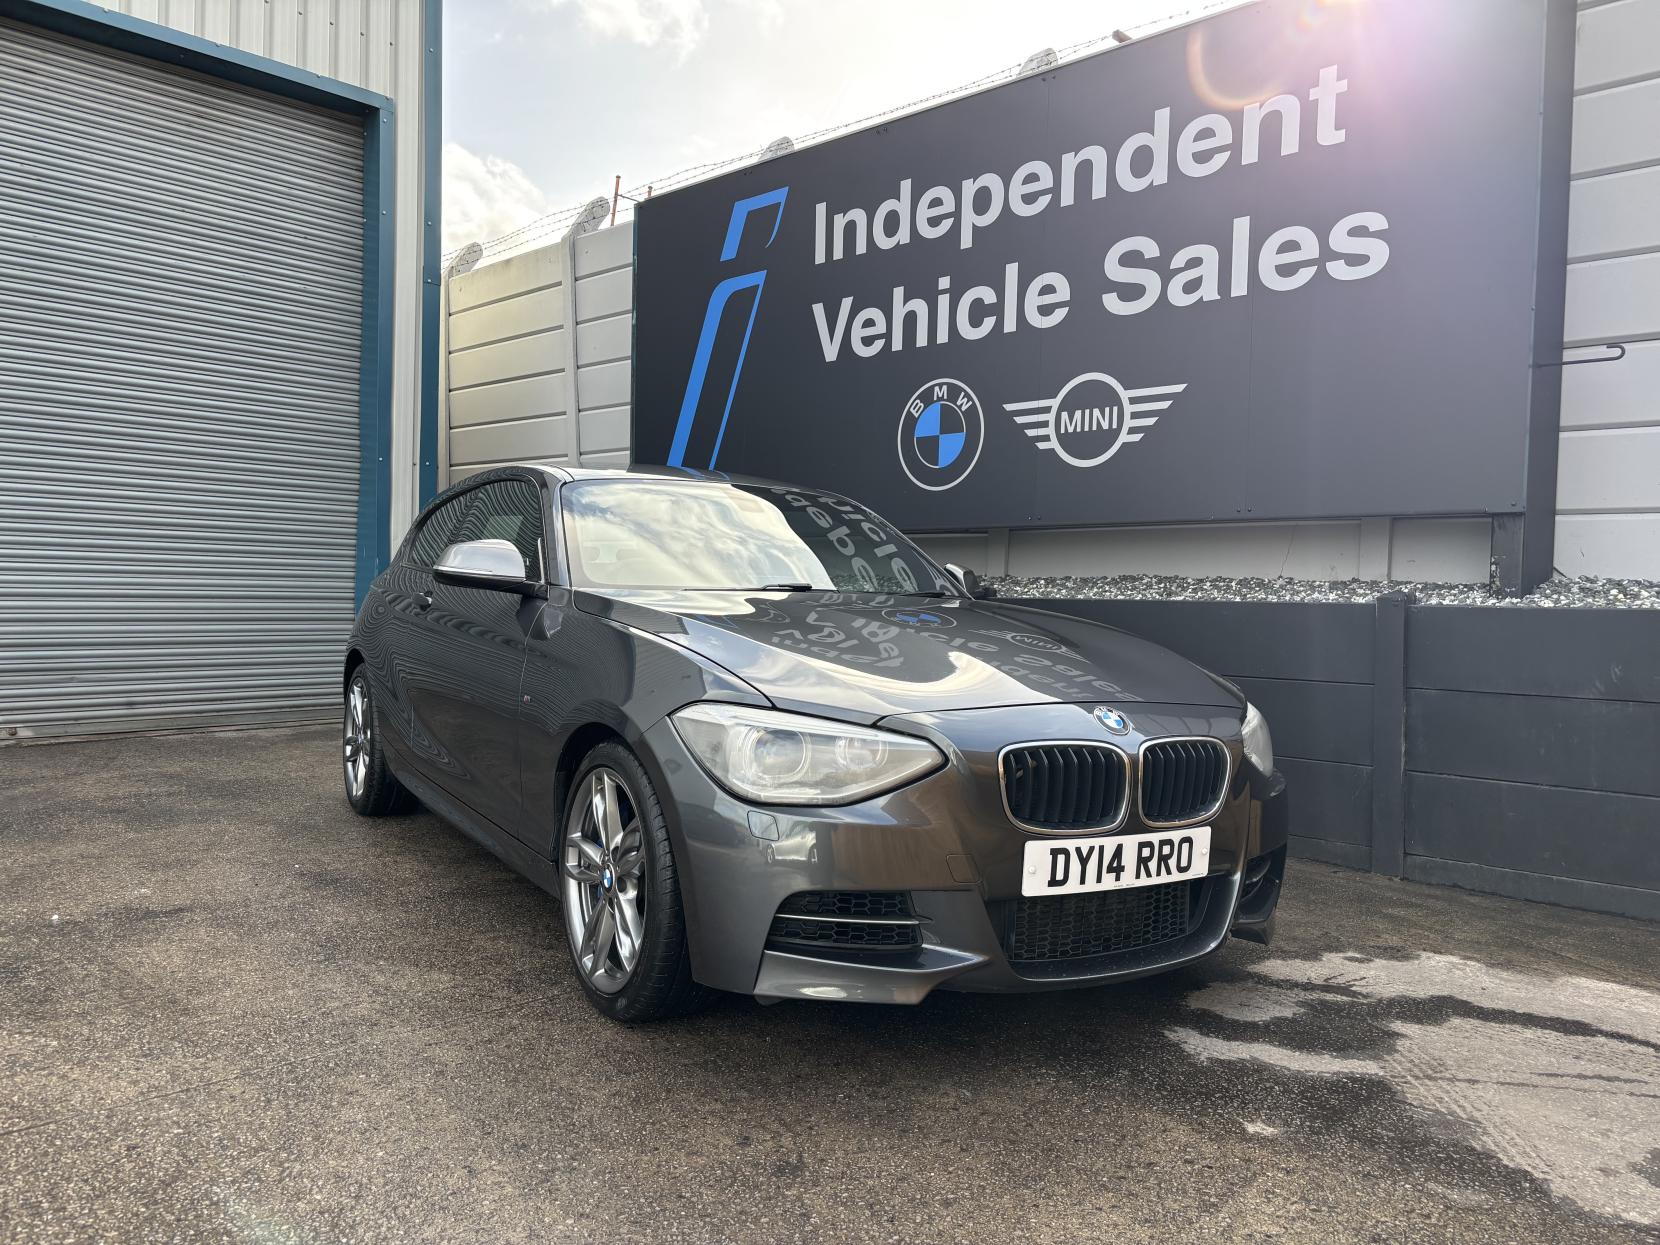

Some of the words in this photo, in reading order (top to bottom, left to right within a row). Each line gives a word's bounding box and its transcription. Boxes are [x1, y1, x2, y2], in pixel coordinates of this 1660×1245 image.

[814, 64, 1350, 265] Independent
[811, 262, 1071, 363] Vehicle
[1102, 210, 1391, 316] Sales
[909, 384, 974, 418] BMW
[1060, 405, 1119, 434] MINI
[1047, 843, 1126, 888] DY14
[1134, 835, 1194, 880] RRO
